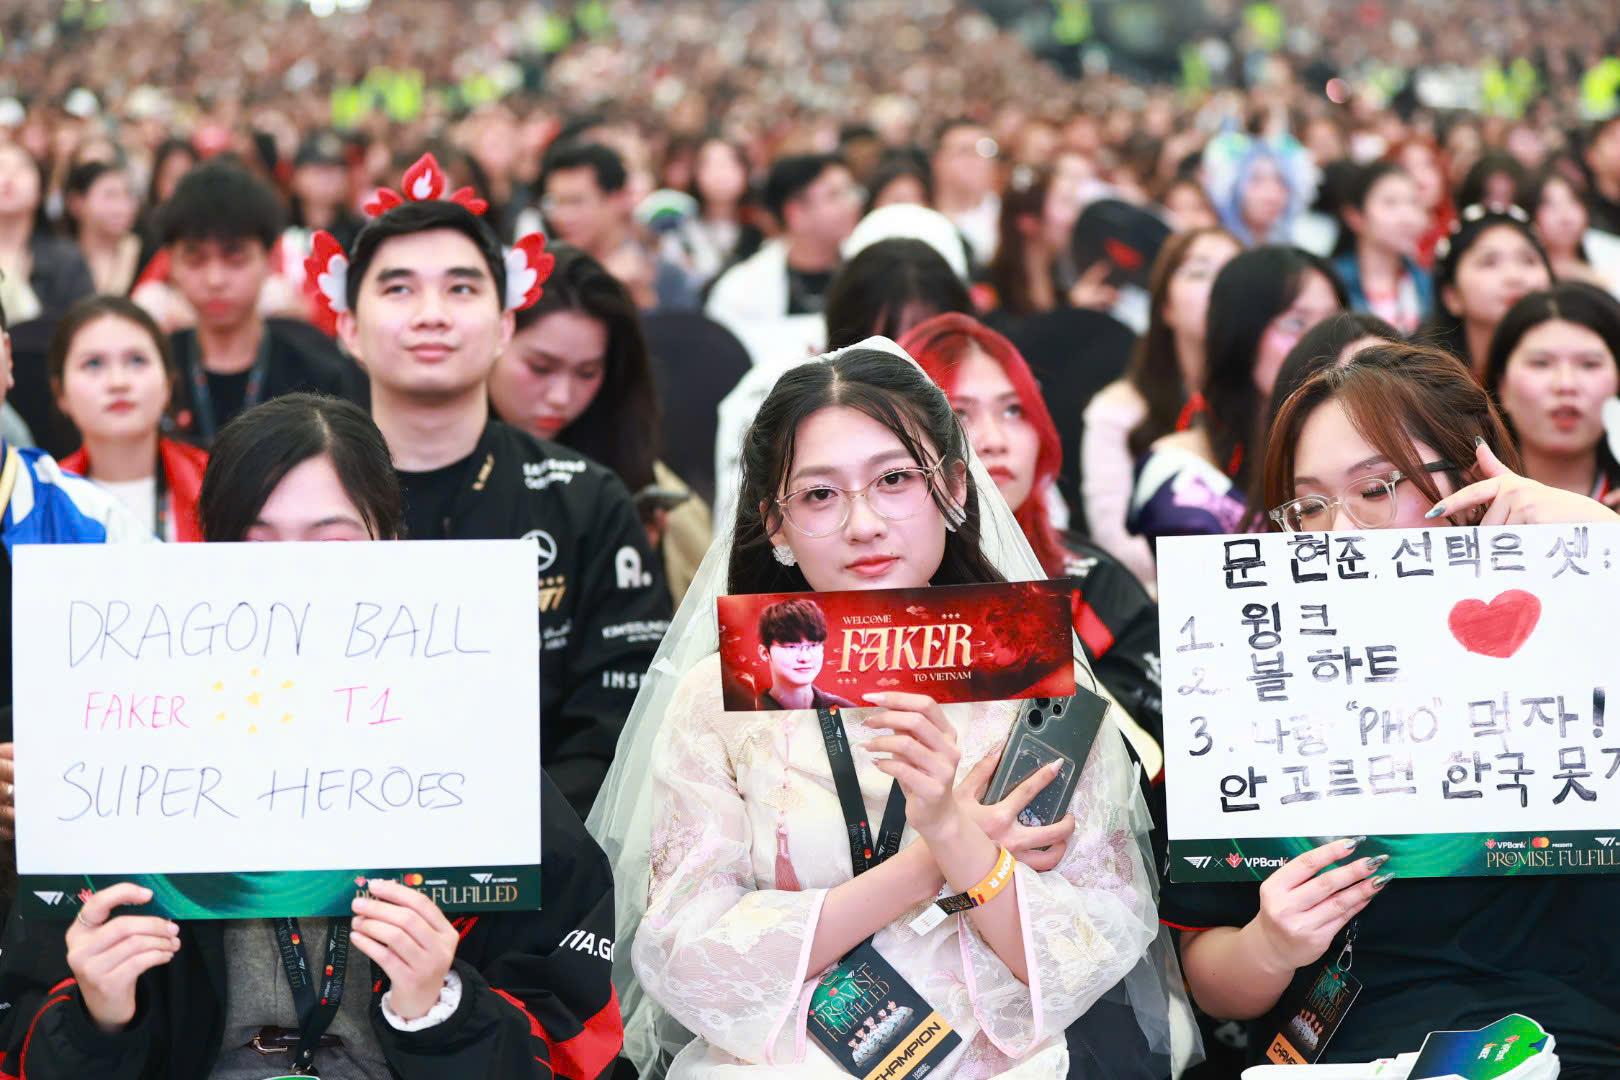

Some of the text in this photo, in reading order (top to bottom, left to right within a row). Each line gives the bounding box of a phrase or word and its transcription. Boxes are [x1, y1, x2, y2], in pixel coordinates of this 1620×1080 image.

[1391, 527, 1526, 579] 선택은
[69, 600, 311, 668] DRAGON
[344, 601, 491, 659] BALL
[842, 614, 892, 625] WELCOME
[837, 623, 974, 673] FAKER
[1246, 650, 1294, 702] 볼
[1306, 645, 1401, 685] 하트
[913, 671, 972, 683] TO VIETNAM
[84, 685, 402, 730] FAKER T1
[57, 761, 465, 822] SUPER HEROES
[1219, 765, 1268, 813] 안
[1442, 750, 1536, 808] 한국
[1486, 850, 1555, 868] PROMISE
[1497, 841, 1527, 849] VPBank
[431, 884, 519, 905] FULFILLED
[813, 965, 881, 1031] PROMISE
[826, 977, 890, 1042] FULFILLED
